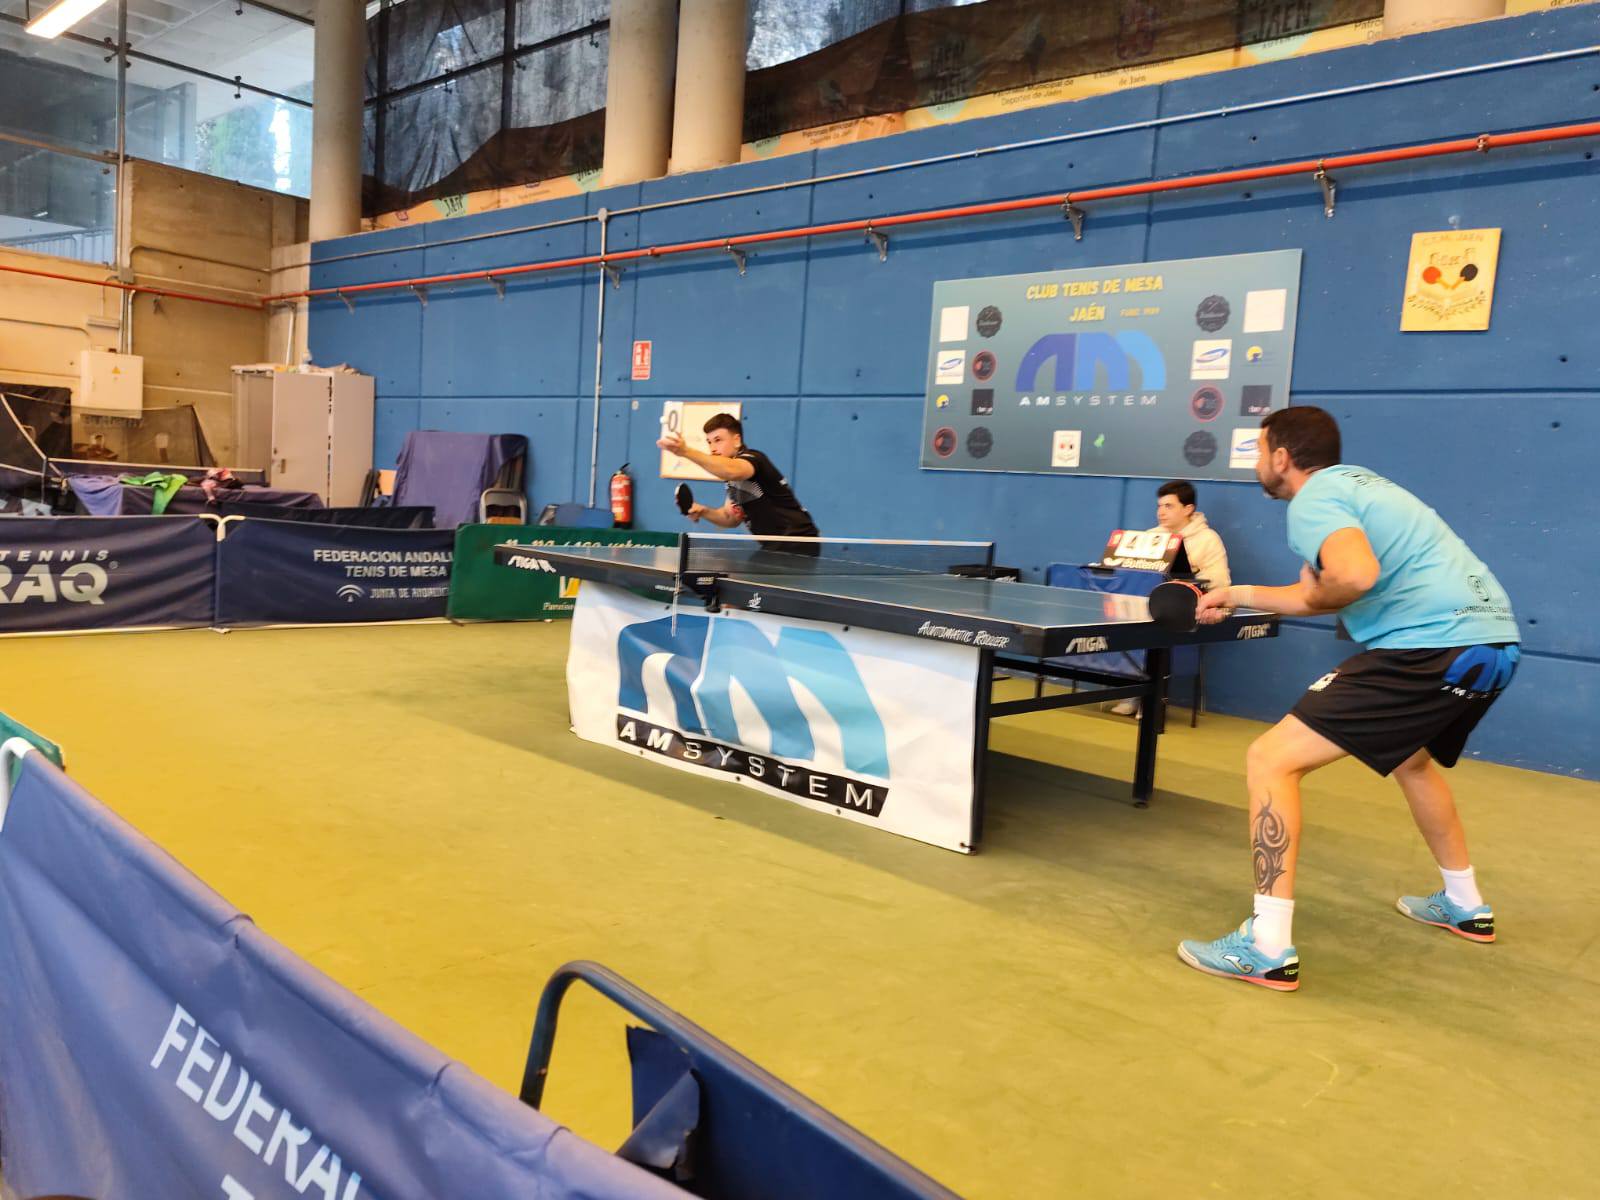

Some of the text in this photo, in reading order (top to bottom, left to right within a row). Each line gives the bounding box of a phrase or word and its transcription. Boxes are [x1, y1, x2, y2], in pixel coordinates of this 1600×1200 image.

[1026, 275, 1164, 300] CLUB TENIS DE MESA
[0, 550, 110, 562] TENNIS
[313, 549, 401, 563] FEDERACION
[344, 565, 448, 578] TENIS DE MESA
